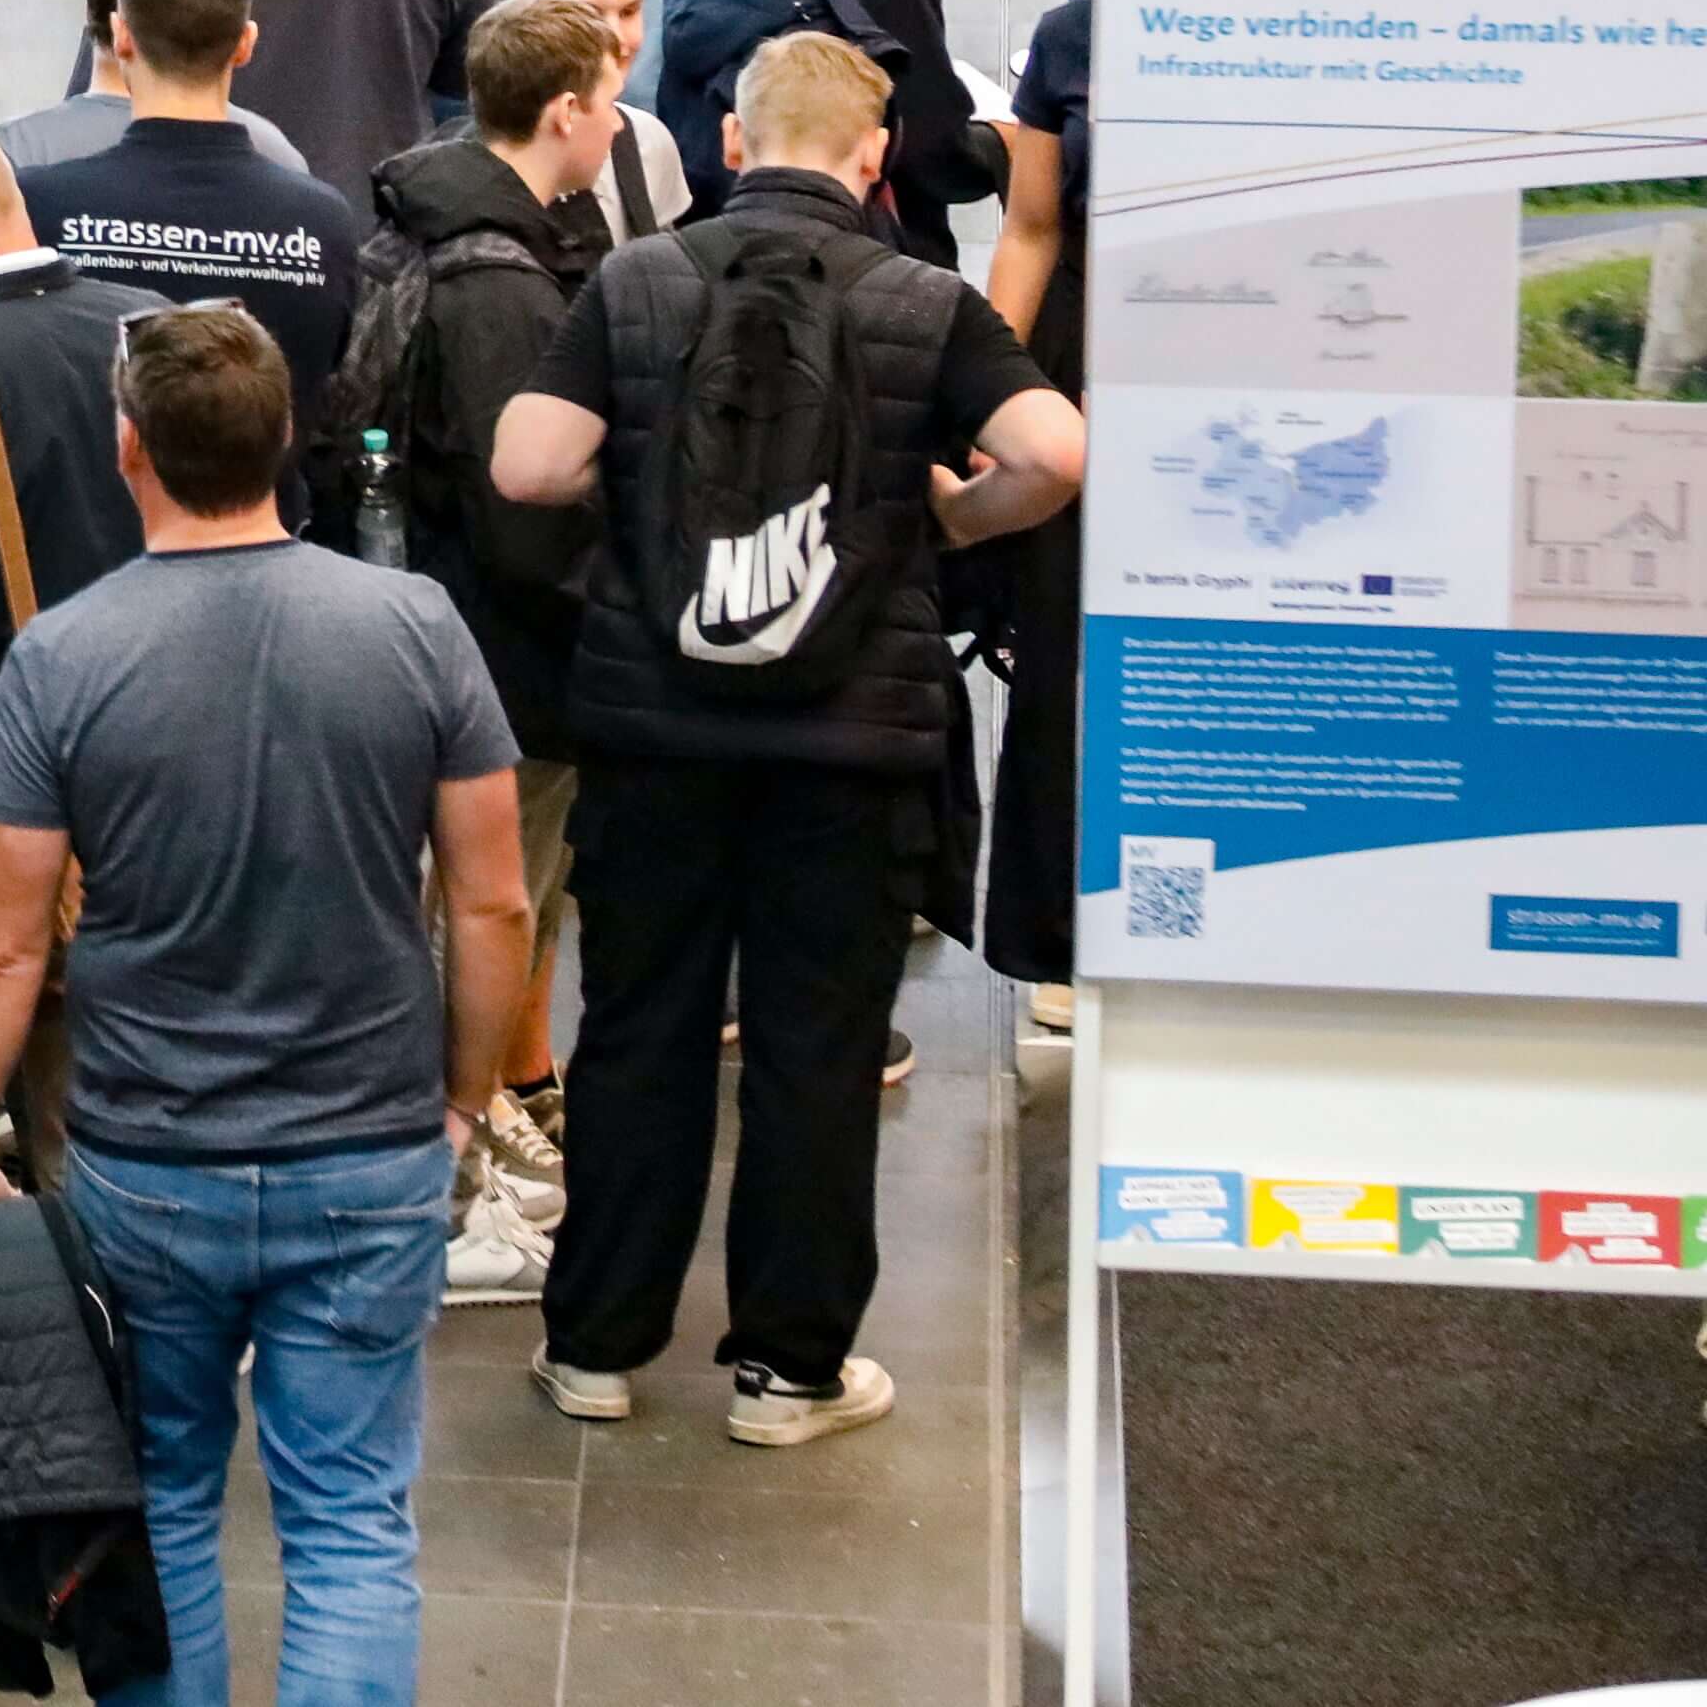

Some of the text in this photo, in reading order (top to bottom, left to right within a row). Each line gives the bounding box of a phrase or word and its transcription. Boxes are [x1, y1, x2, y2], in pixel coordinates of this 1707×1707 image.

[1139, 6, 1235, 41] Wege
[1244, 10, 1418, 41] verbinden
[1457, 13, 1584, 45] damals
[1594, 18, 1657, 47] wie
[1666, 19, 1707, 47] he
[1137, 54, 1524, 86] Infrastruktur mit Geschichte
[61, 214, 321, 261] strassen-mv.de
[141, 259, 171, 273] und
[170, 259, 304, 286] Verkehrsverwaltung
